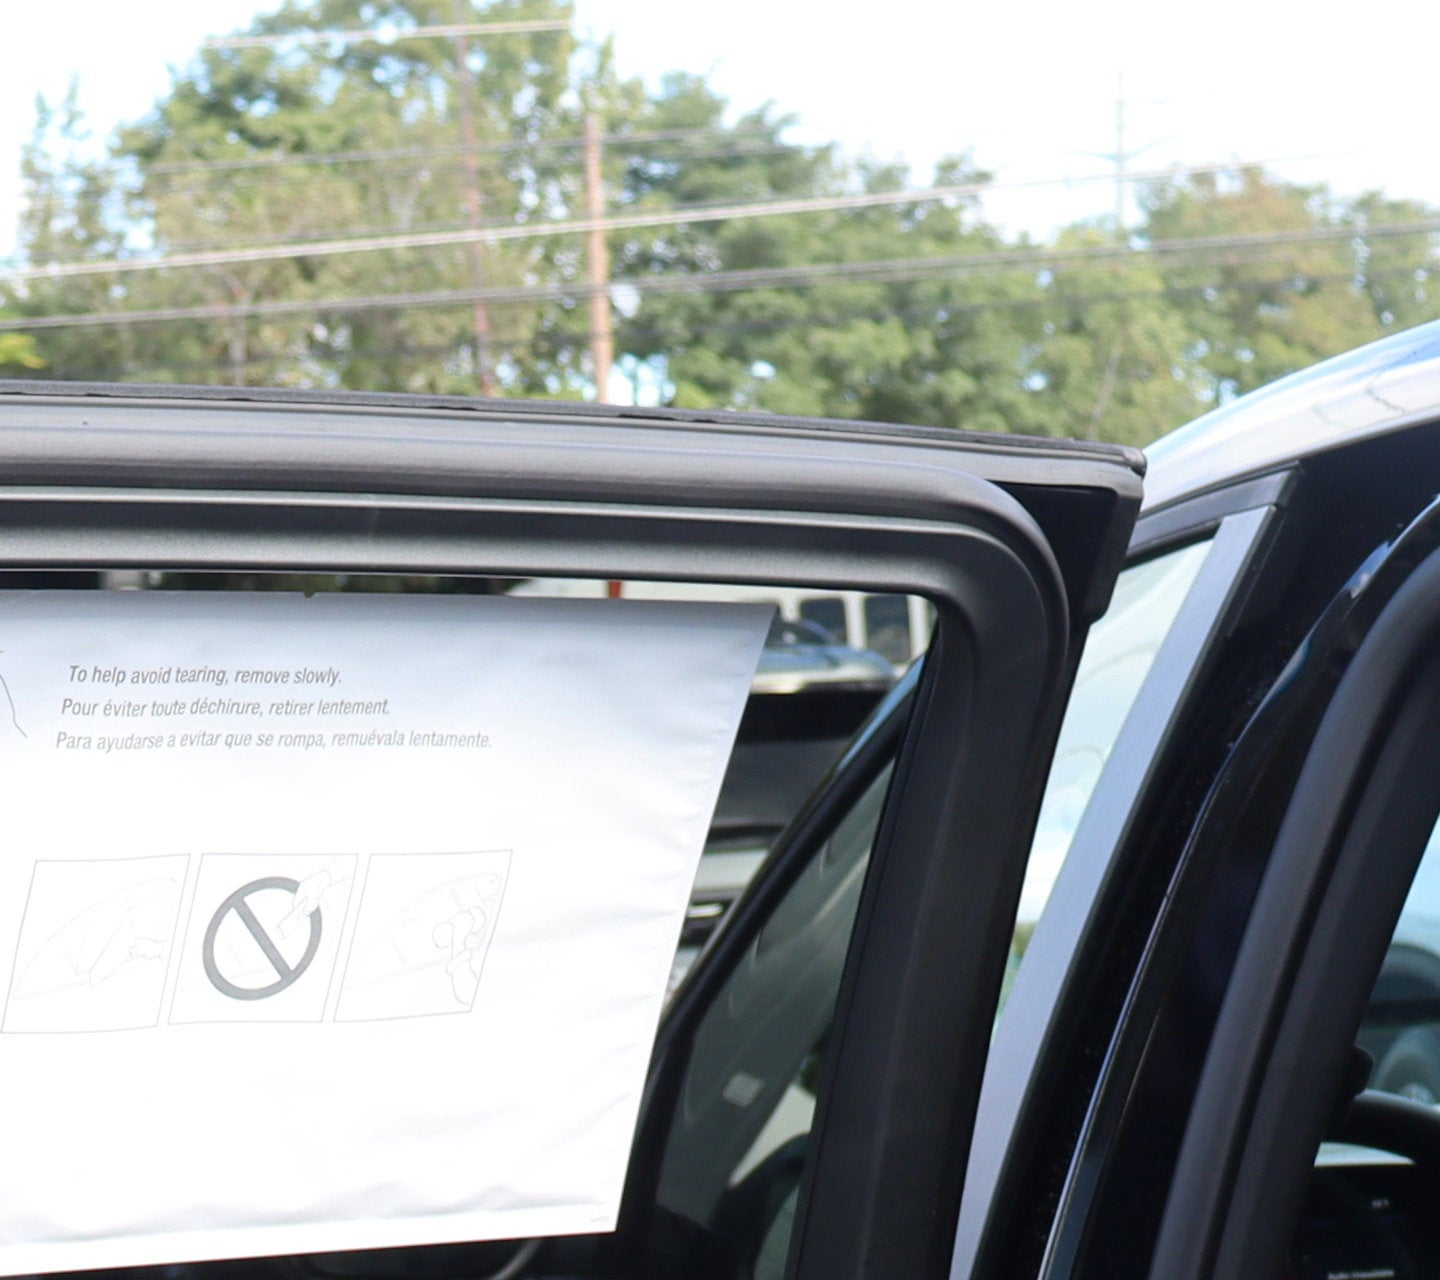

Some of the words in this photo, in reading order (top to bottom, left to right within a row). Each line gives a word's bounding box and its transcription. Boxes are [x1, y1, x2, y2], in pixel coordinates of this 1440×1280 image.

[69, 666, 87, 682] To
[91, 666, 126, 686] help
[131, 667, 171, 684] avoid
[175, 666, 229, 686] tearing,
[234, 669, 289, 684] remove
[294, 667, 342, 687] slowly.
[61, 699, 99, 716] Pour
[103, 699, 147, 717] éviter
[151, 701, 185, 717] toute
[190, 698, 263, 717] déchirure,
[268, 700, 314, 716] retirer
[317, 699, 390, 715] lentement.
[56, 731, 91, 749] Para
[97, 733, 163, 753] ayudarse
[167, 735, 176, 747] a
[180, 730, 221, 747] evitar
[224, 733, 253, 749] que
[257, 733, 274, 747] se
[278, 732, 327, 750] rompa,
[332, 730, 405, 747] remuévala
[409, 730, 492, 748] lentamente.
